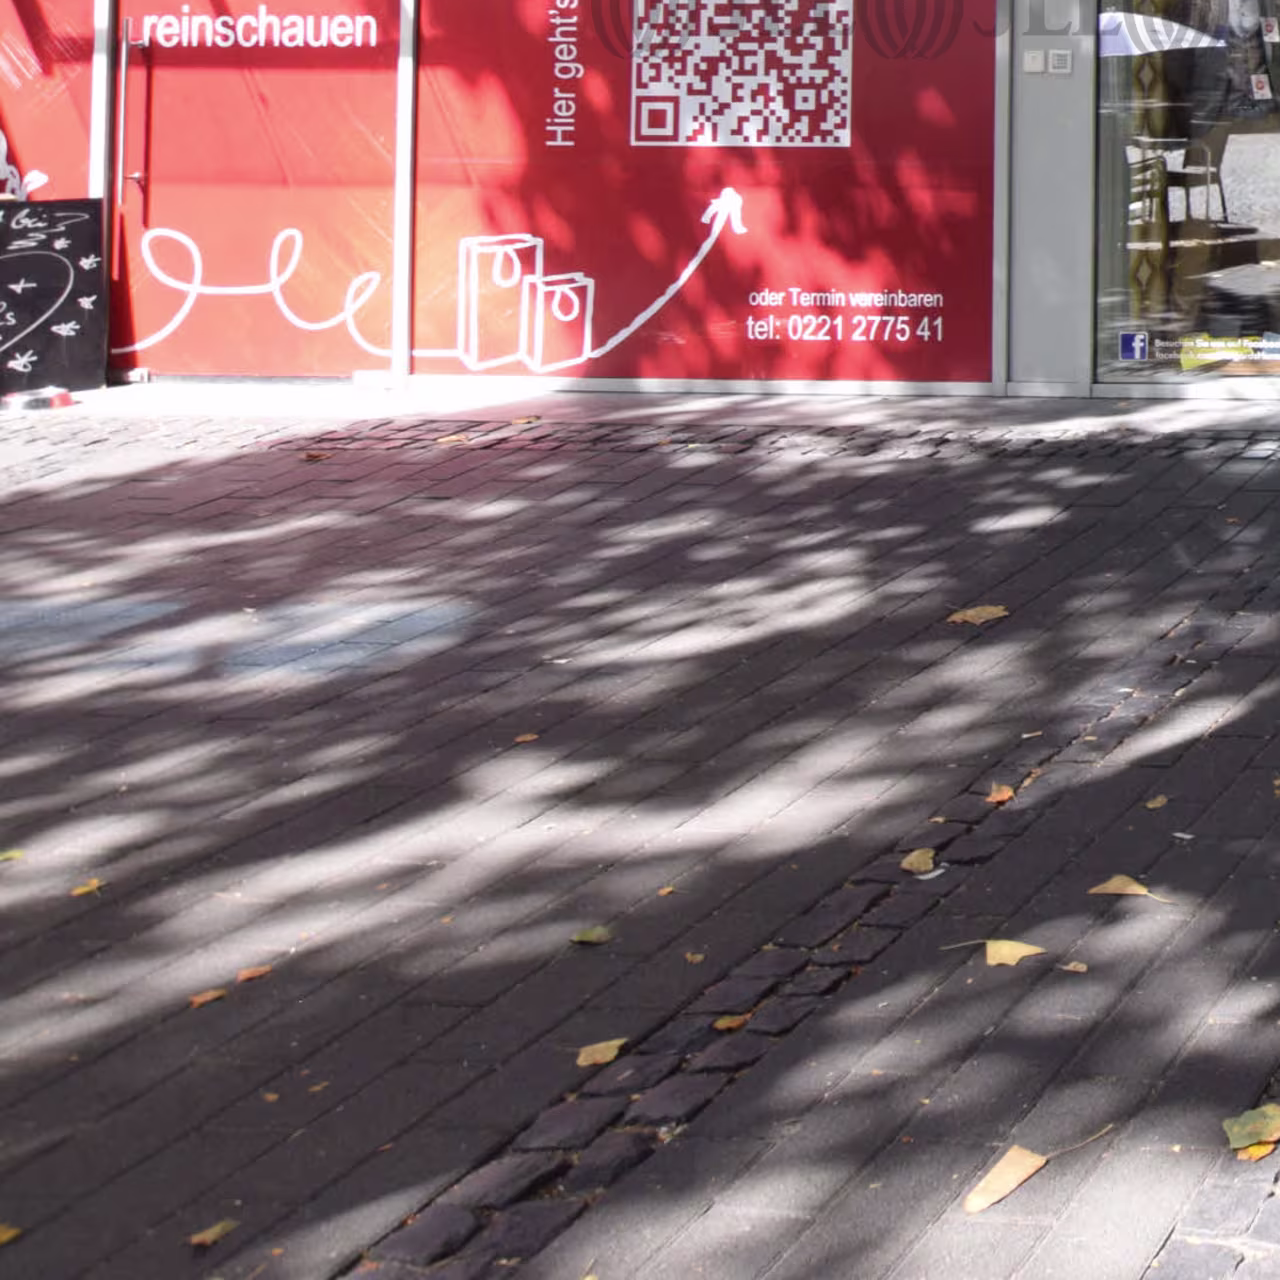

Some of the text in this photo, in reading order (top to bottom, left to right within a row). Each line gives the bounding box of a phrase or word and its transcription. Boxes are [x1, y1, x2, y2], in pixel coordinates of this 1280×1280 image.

[143, 4, 378, 48] reinschauen
[545, 87, 576, 146] Hier
[749, 288, 944, 308] oder Termin vereinbaren
[746, 315, 943, 342] tel: 0221 2775 41
